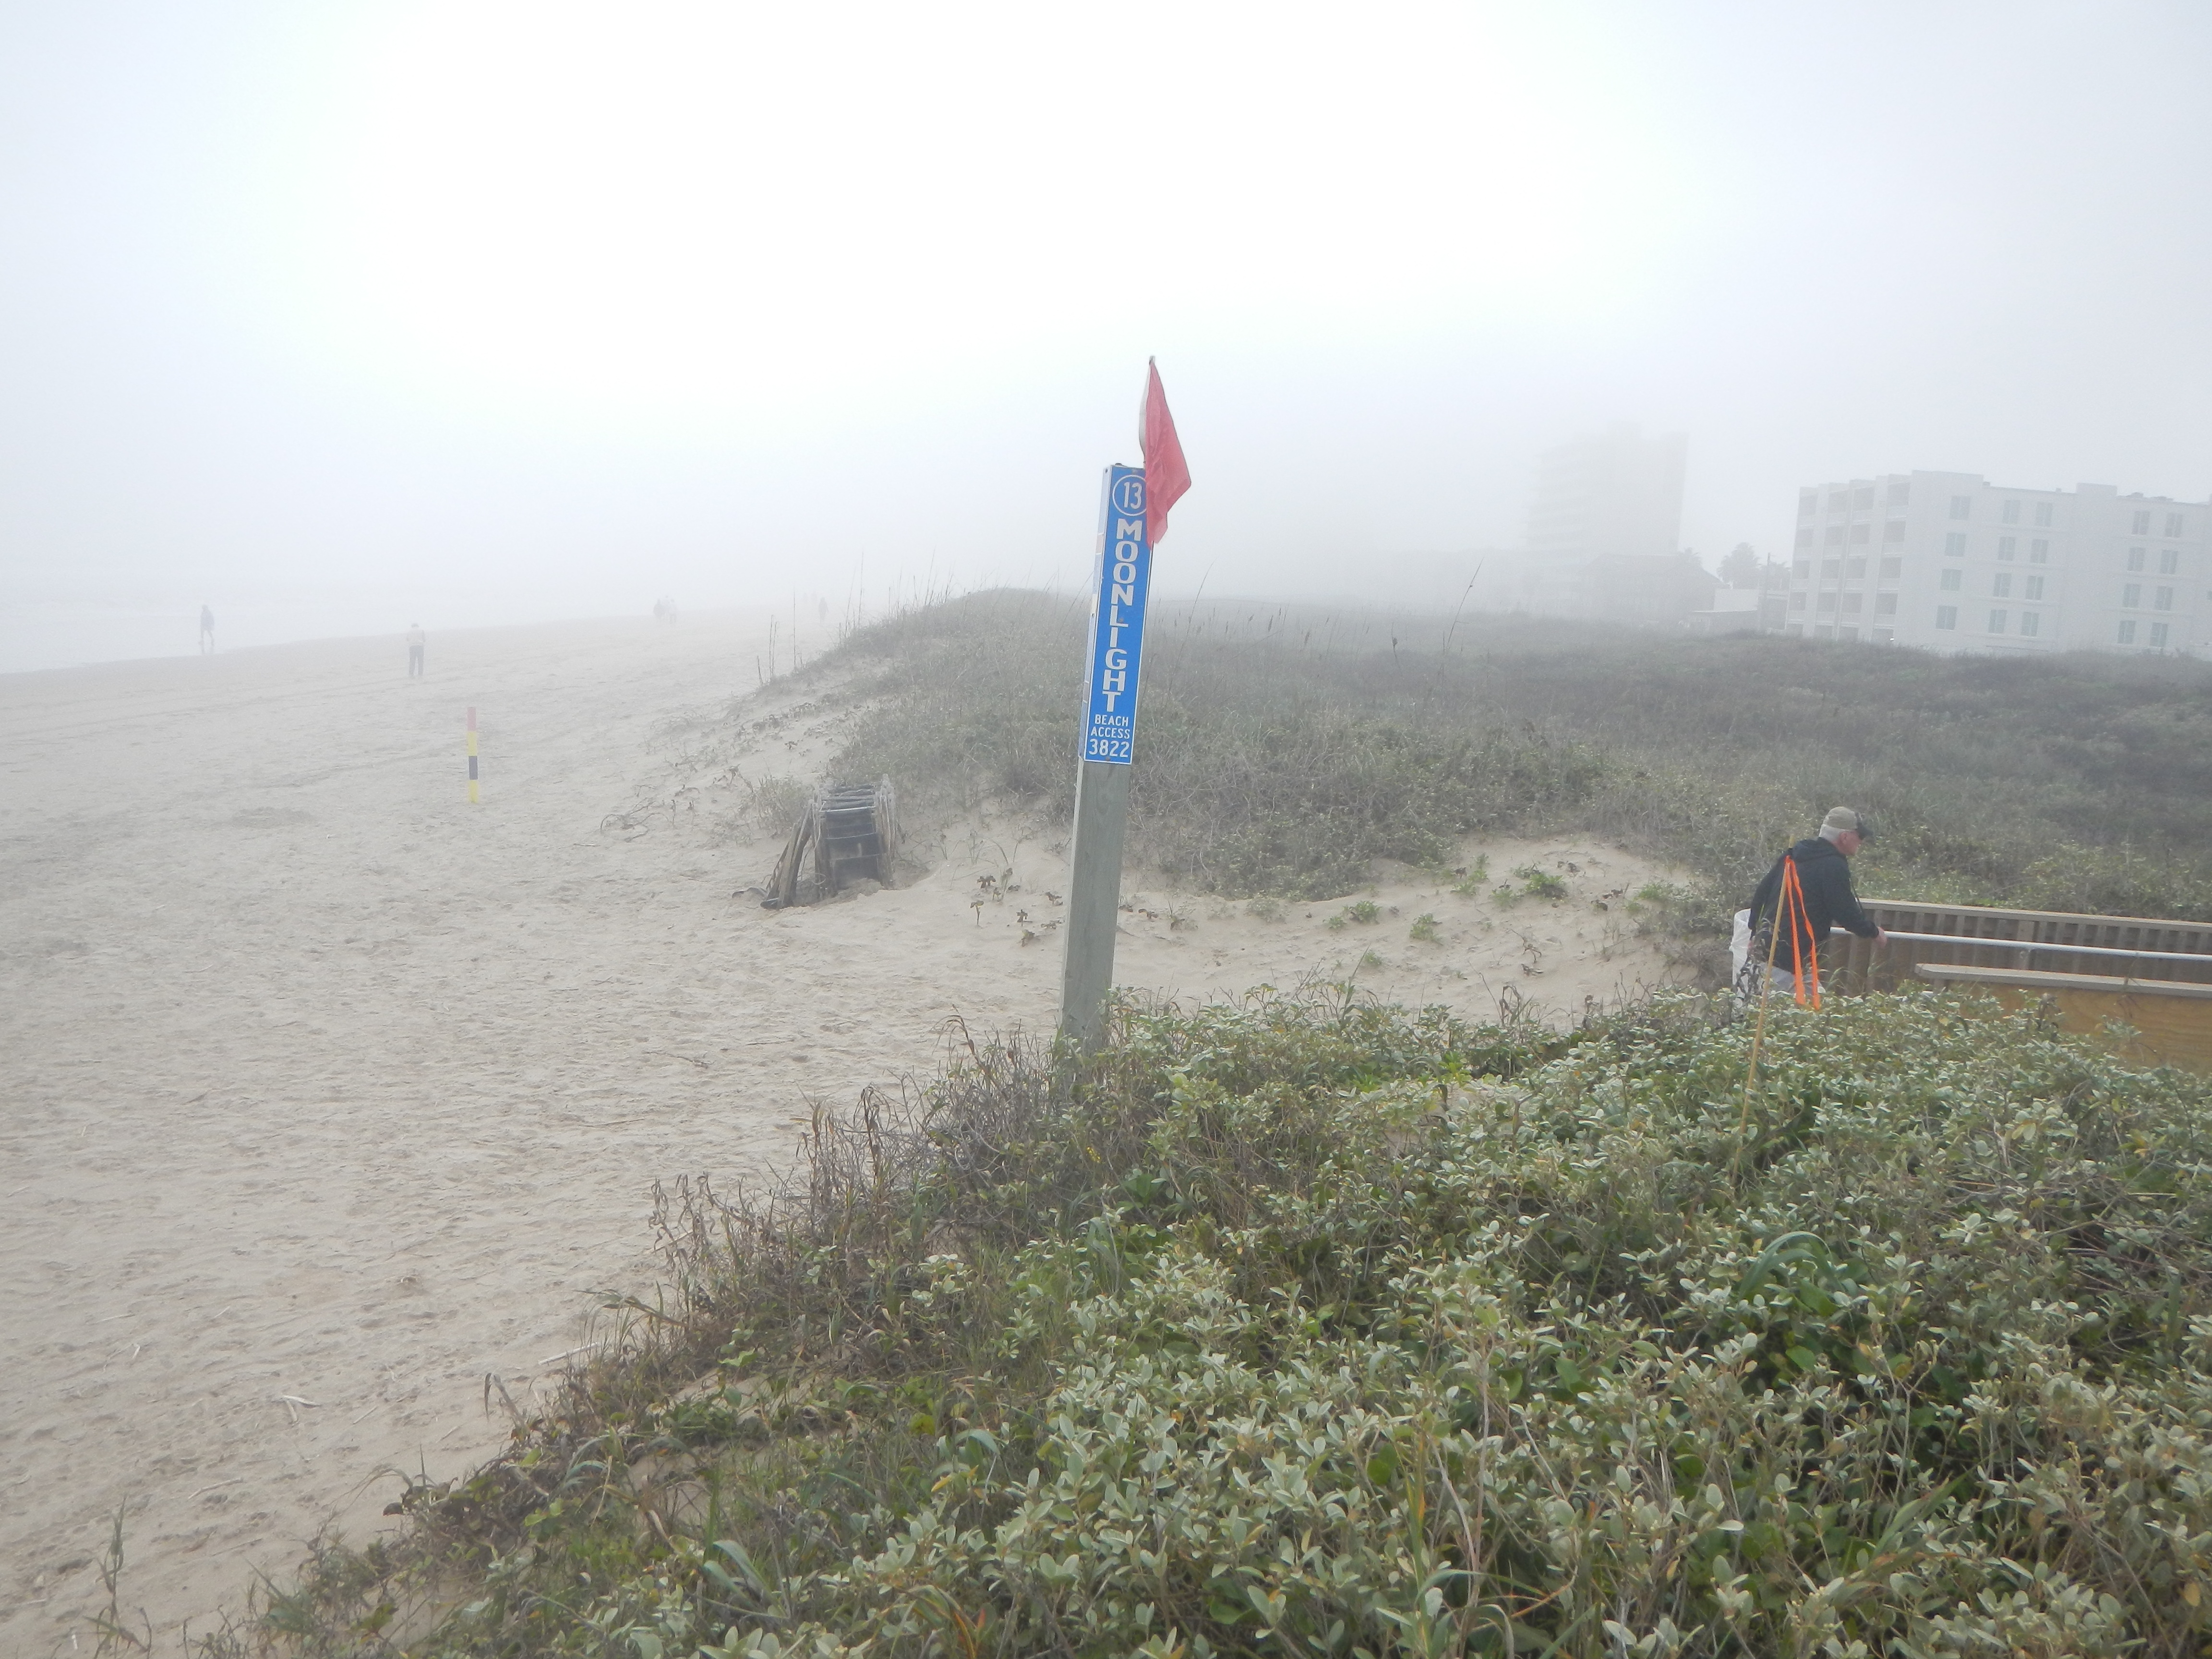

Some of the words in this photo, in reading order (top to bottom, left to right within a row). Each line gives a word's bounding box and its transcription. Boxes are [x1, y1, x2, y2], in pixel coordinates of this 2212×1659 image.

[1124, 481, 1142, 509] 13
[1102, 518, 1142, 712] MOONLIGHT
[1094, 714, 1129, 727] BEACH
[1090, 726, 1130, 739] ACCESS
[1089, 738, 1130, 757] 3822
